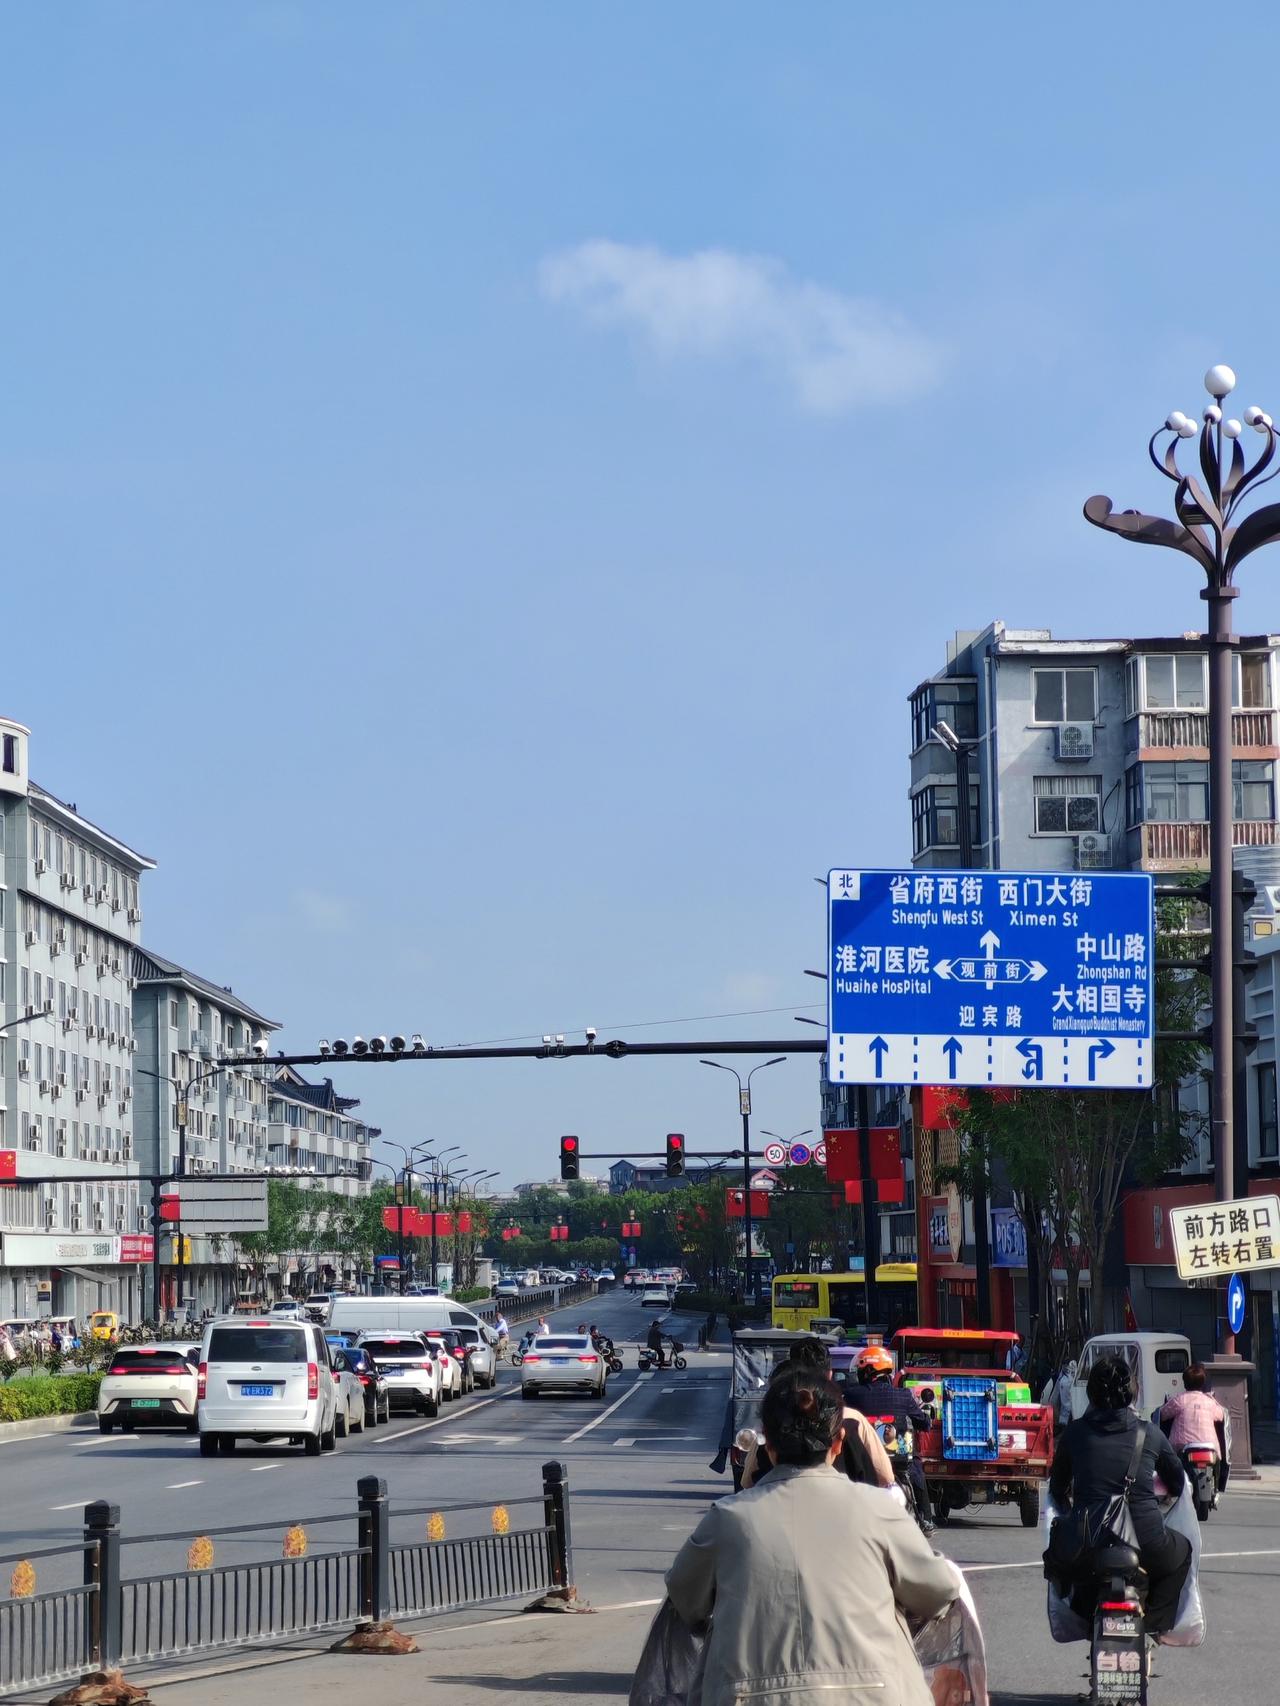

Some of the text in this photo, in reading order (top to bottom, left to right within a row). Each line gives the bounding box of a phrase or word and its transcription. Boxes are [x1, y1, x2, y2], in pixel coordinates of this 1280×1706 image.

[839, 874, 853, 888] 北
[889, 875, 1092, 907] 省府西街 西门大街
[892, 909, 983, 929] Shengfu West St
[1009, 911, 1078, 927] Ximen St
[1076, 932, 1145, 962] 中山路
[835, 945, 930, 974] 淮河医院
[961, 962, 1020, 980] 观前街
[1077, 964, 1147, 983] Zhongshan Rd
[836, 978, 879, 994] Huaihe
[1051, 983, 1146, 1013] 大相国寺
[959, 1005, 1022, 1028] 迎宾路
[1118, 1017, 1146, 1034] Monastery
[769, 1149, 781, 1160] 50
[1183, 1207, 1271, 1240] 前方路口
[1189, 1235, 1275, 1269] 左转右置
